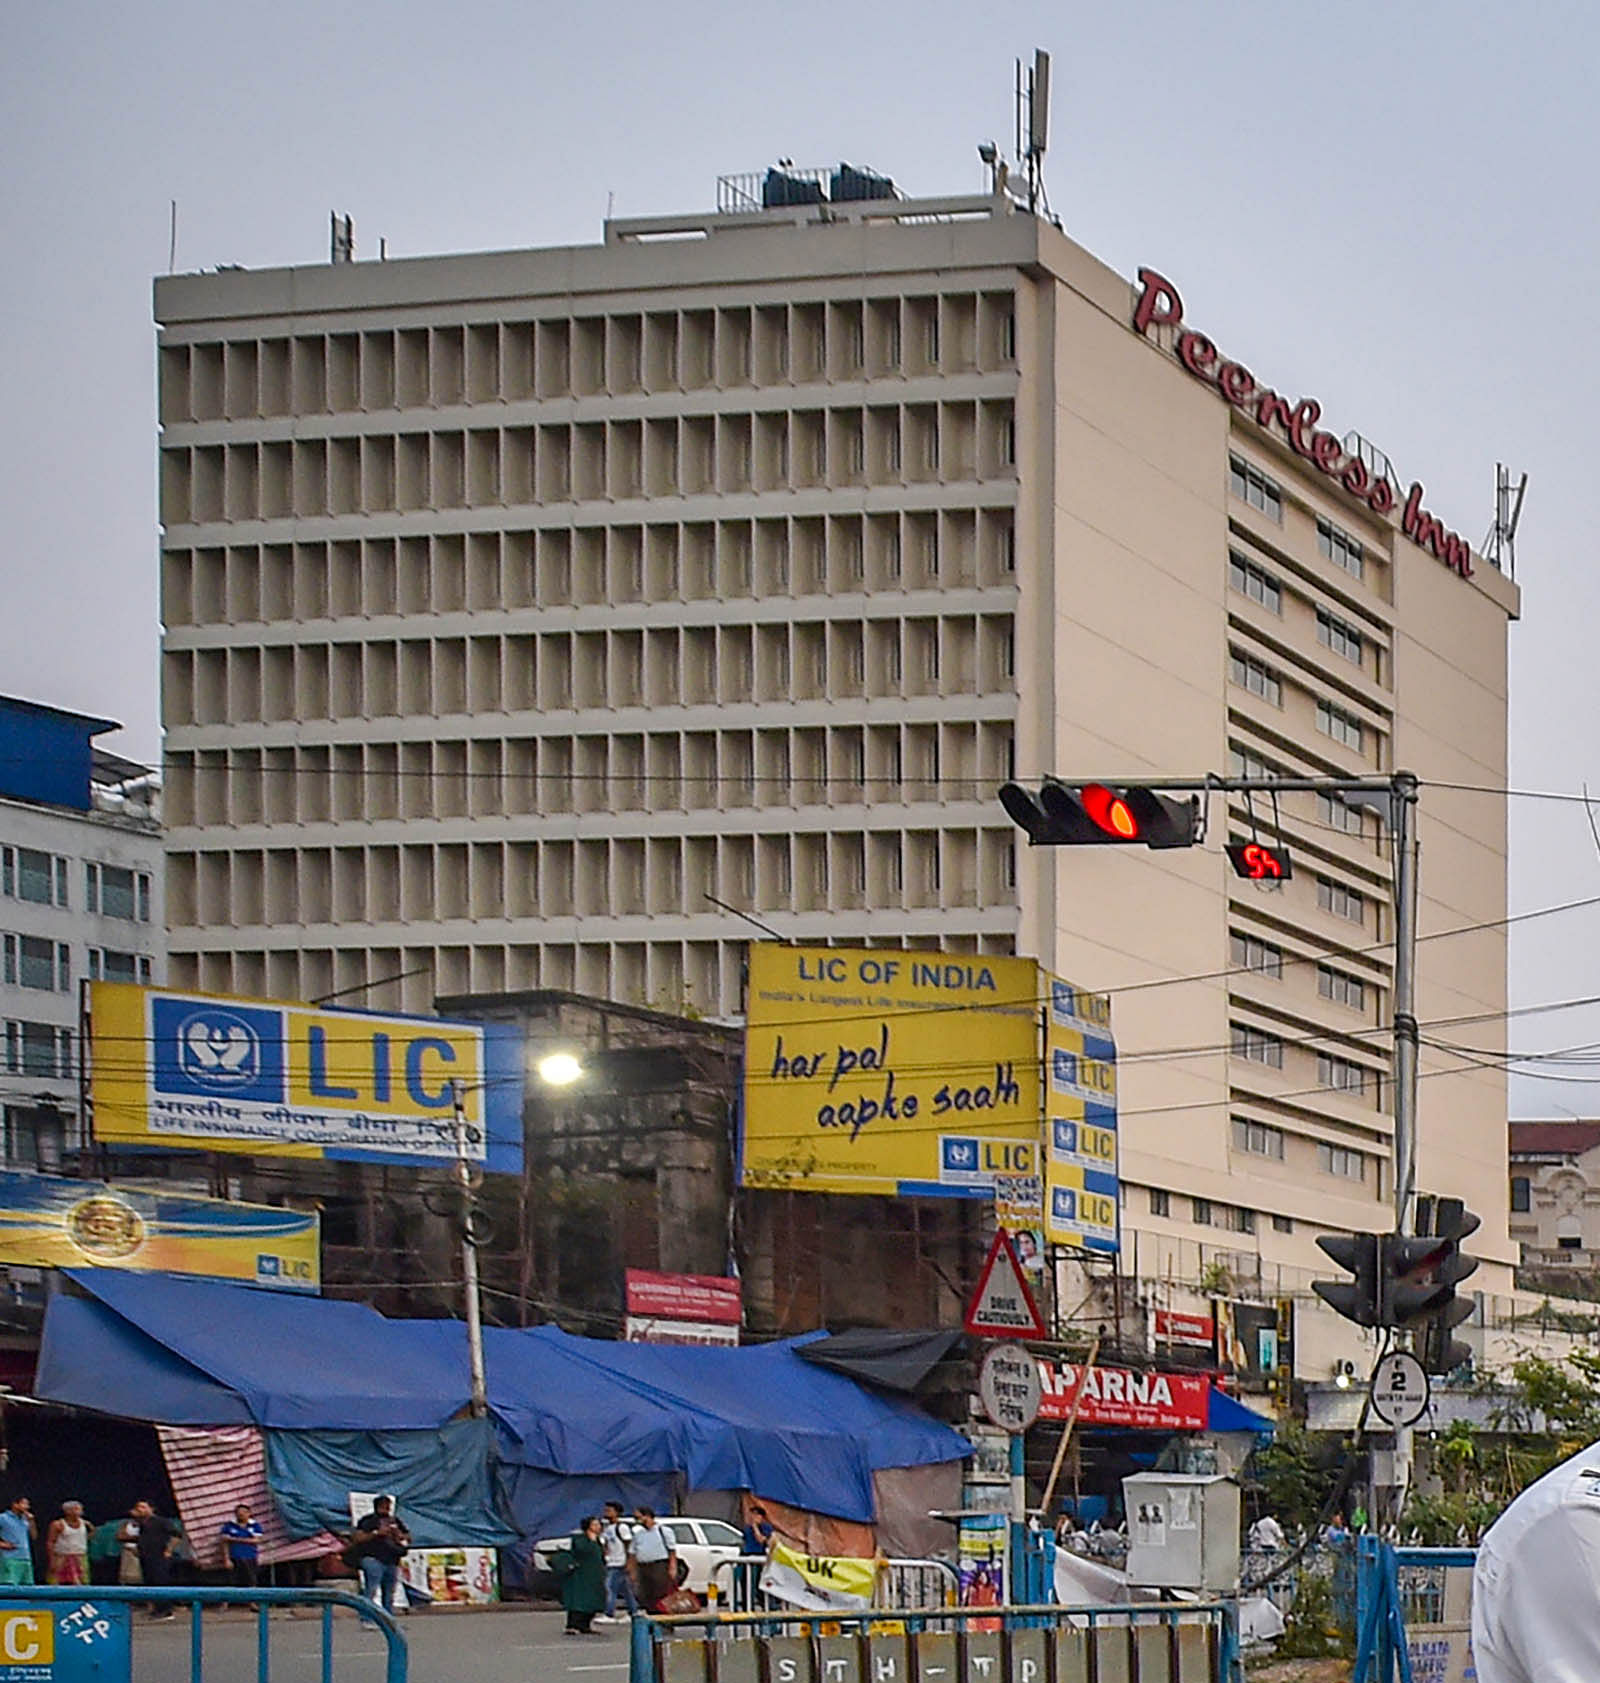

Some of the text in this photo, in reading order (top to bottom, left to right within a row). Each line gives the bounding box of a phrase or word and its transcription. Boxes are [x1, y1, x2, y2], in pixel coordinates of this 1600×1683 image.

[1133, 266, 1474, 568] Peerless Inn
[799, 957, 996, 991] LIC OF INDIA
[309, 1025, 456, 1108] LIC
[771, 1023, 888, 1093] har pal
[1081, 1061, 1110, 1090] LIC
[154, 1100, 241, 1120] भारतीय
[817, 1070, 918, 1143] aapke
[931, 1061, 1020, 1115] saath
[154, 1117, 188, 1129] LIFE
[1081, 1129, 1110, 1157] LIC
[985, 1144, 1029, 1171] LIC
[1081, 1196, 1110, 1224] LIC
[282, 1260, 310, 1279] LIC
[1391, 1372, 1406, 1391] 2
[75, 1619, 110, 1644] TP
[1409, 1641, 1449, 1657] OLKATA
